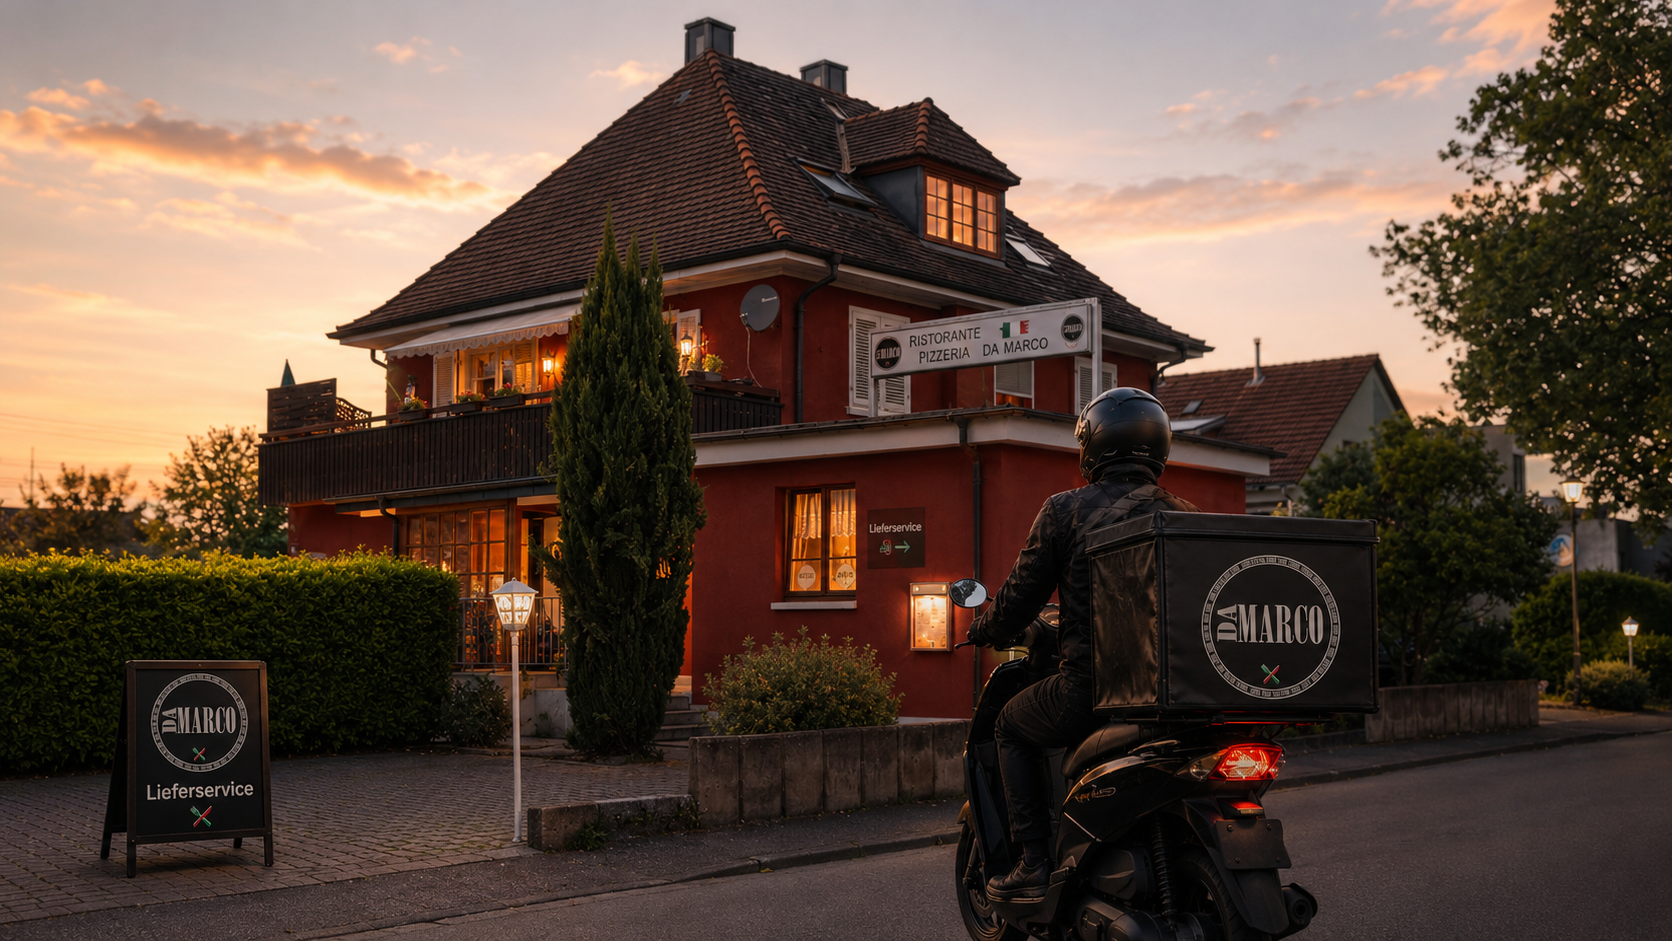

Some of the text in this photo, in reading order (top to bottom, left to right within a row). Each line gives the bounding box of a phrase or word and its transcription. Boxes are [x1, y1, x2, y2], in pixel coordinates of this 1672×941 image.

[909, 327, 981, 348] RISTORANTE
[919, 347, 970, 364] PIZZERIA
[983, 343, 999, 357] DA
[1004, 337, 1048, 354] MARCO
[869, 521, 922, 533] Lieferservice
[1217, 603, 1238, 642] DA
[1238, 603, 1324, 645] MARCO
[162, 707, 177, 734] DA
[177, 706, 237, 734] MARCO
[146, 781, 254, 800] Lieferservice
